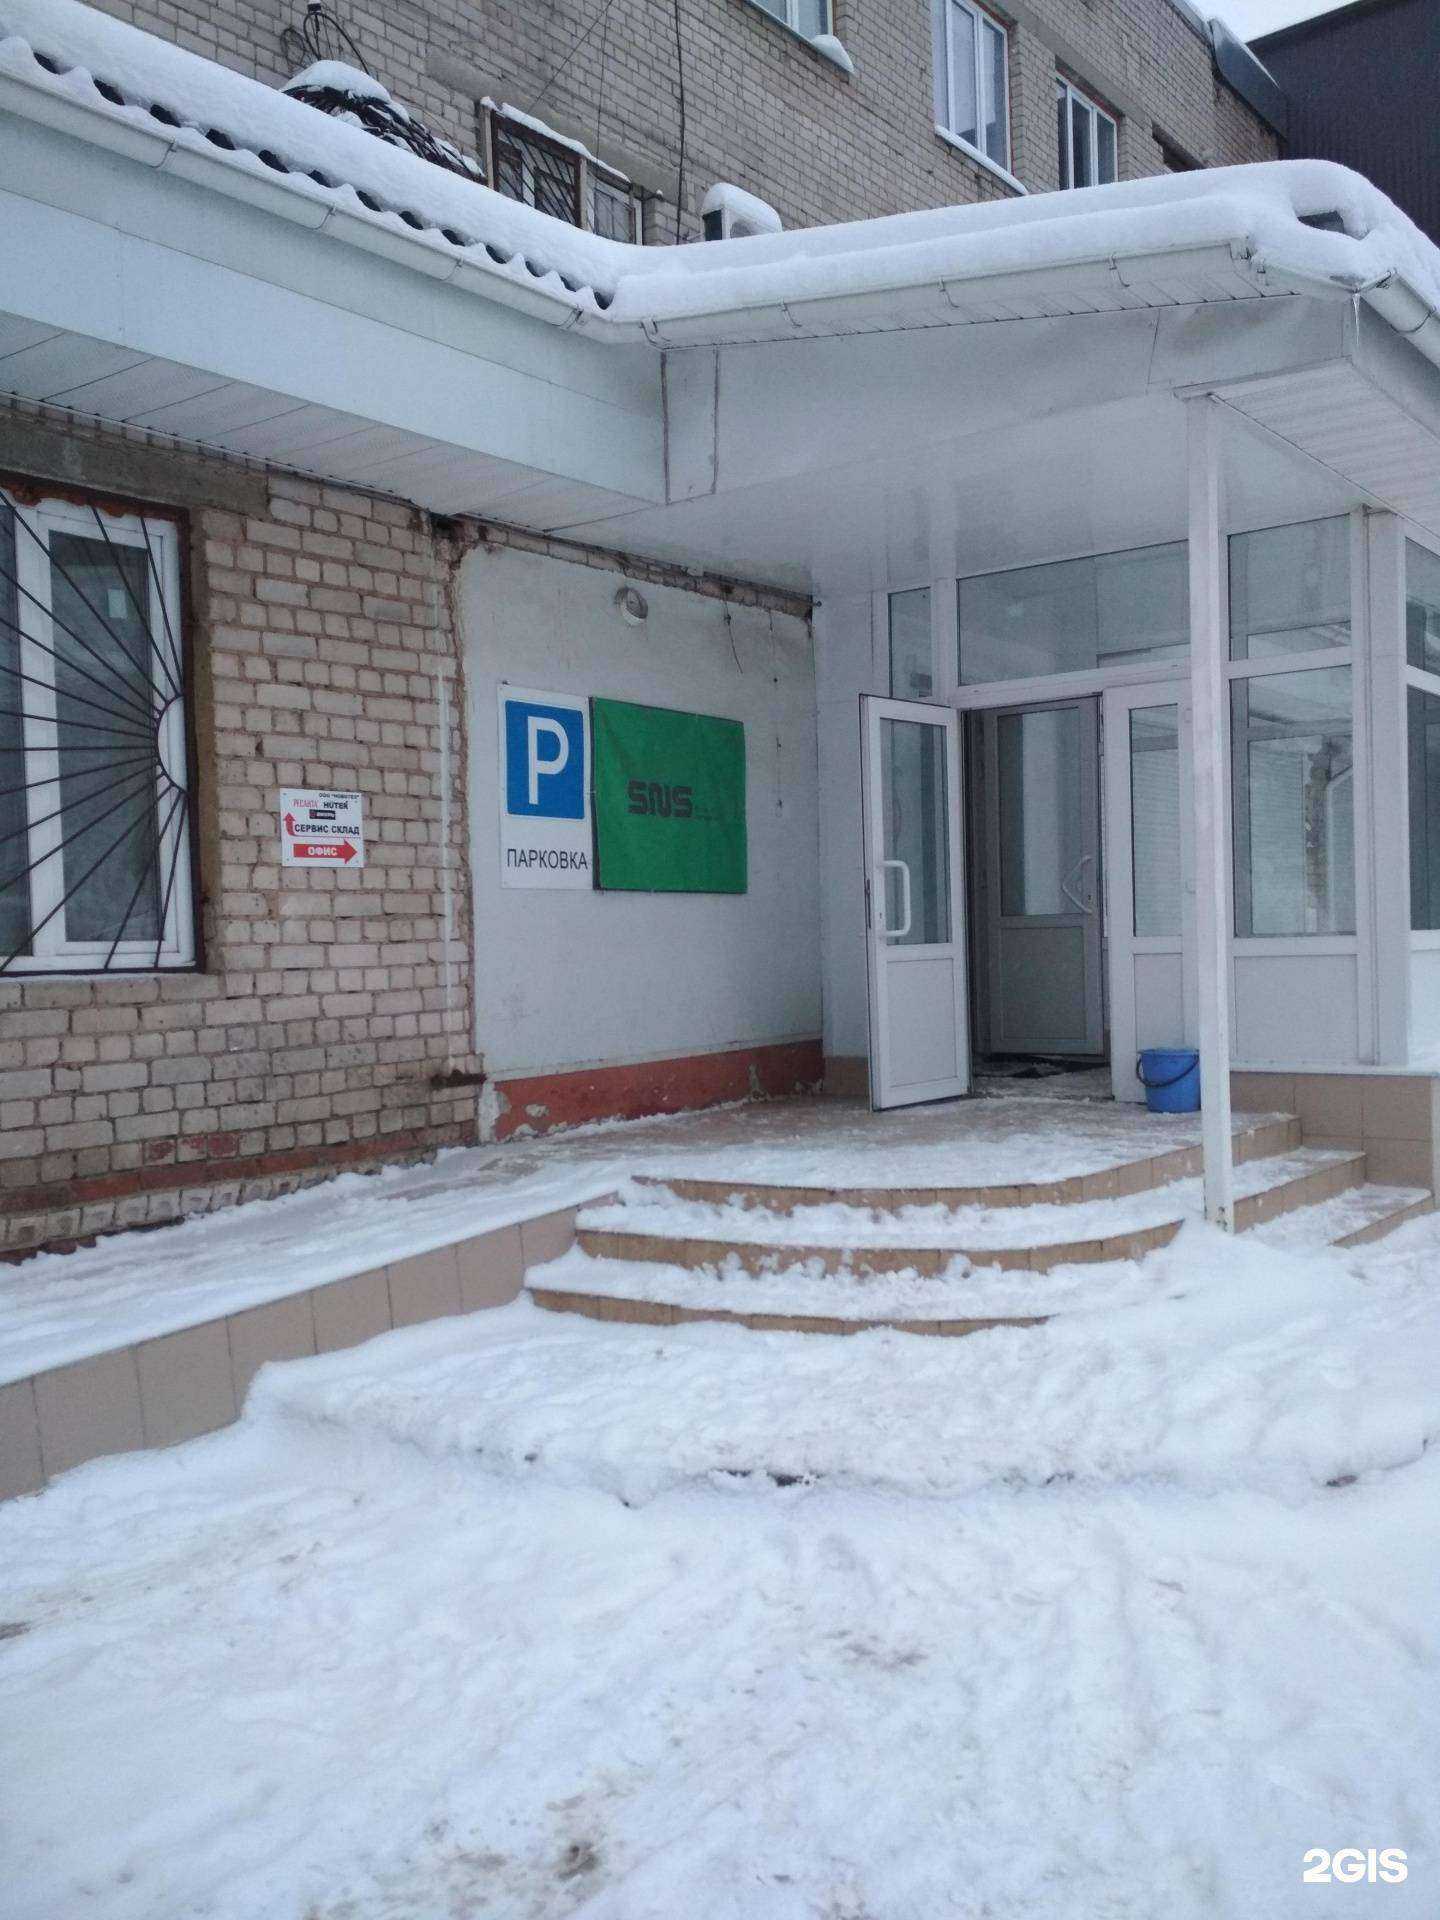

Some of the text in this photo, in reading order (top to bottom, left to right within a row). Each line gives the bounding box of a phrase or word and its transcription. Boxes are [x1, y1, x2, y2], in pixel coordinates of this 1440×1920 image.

[527, 716, 570, 806] P
[627, 780, 694, 819] SNS
[294, 824, 360, 835] СЕРВИС СКЛАД
[307, 846, 338, 856] ОФИС
[506, 848, 589, 870] ПАРКОВКА
